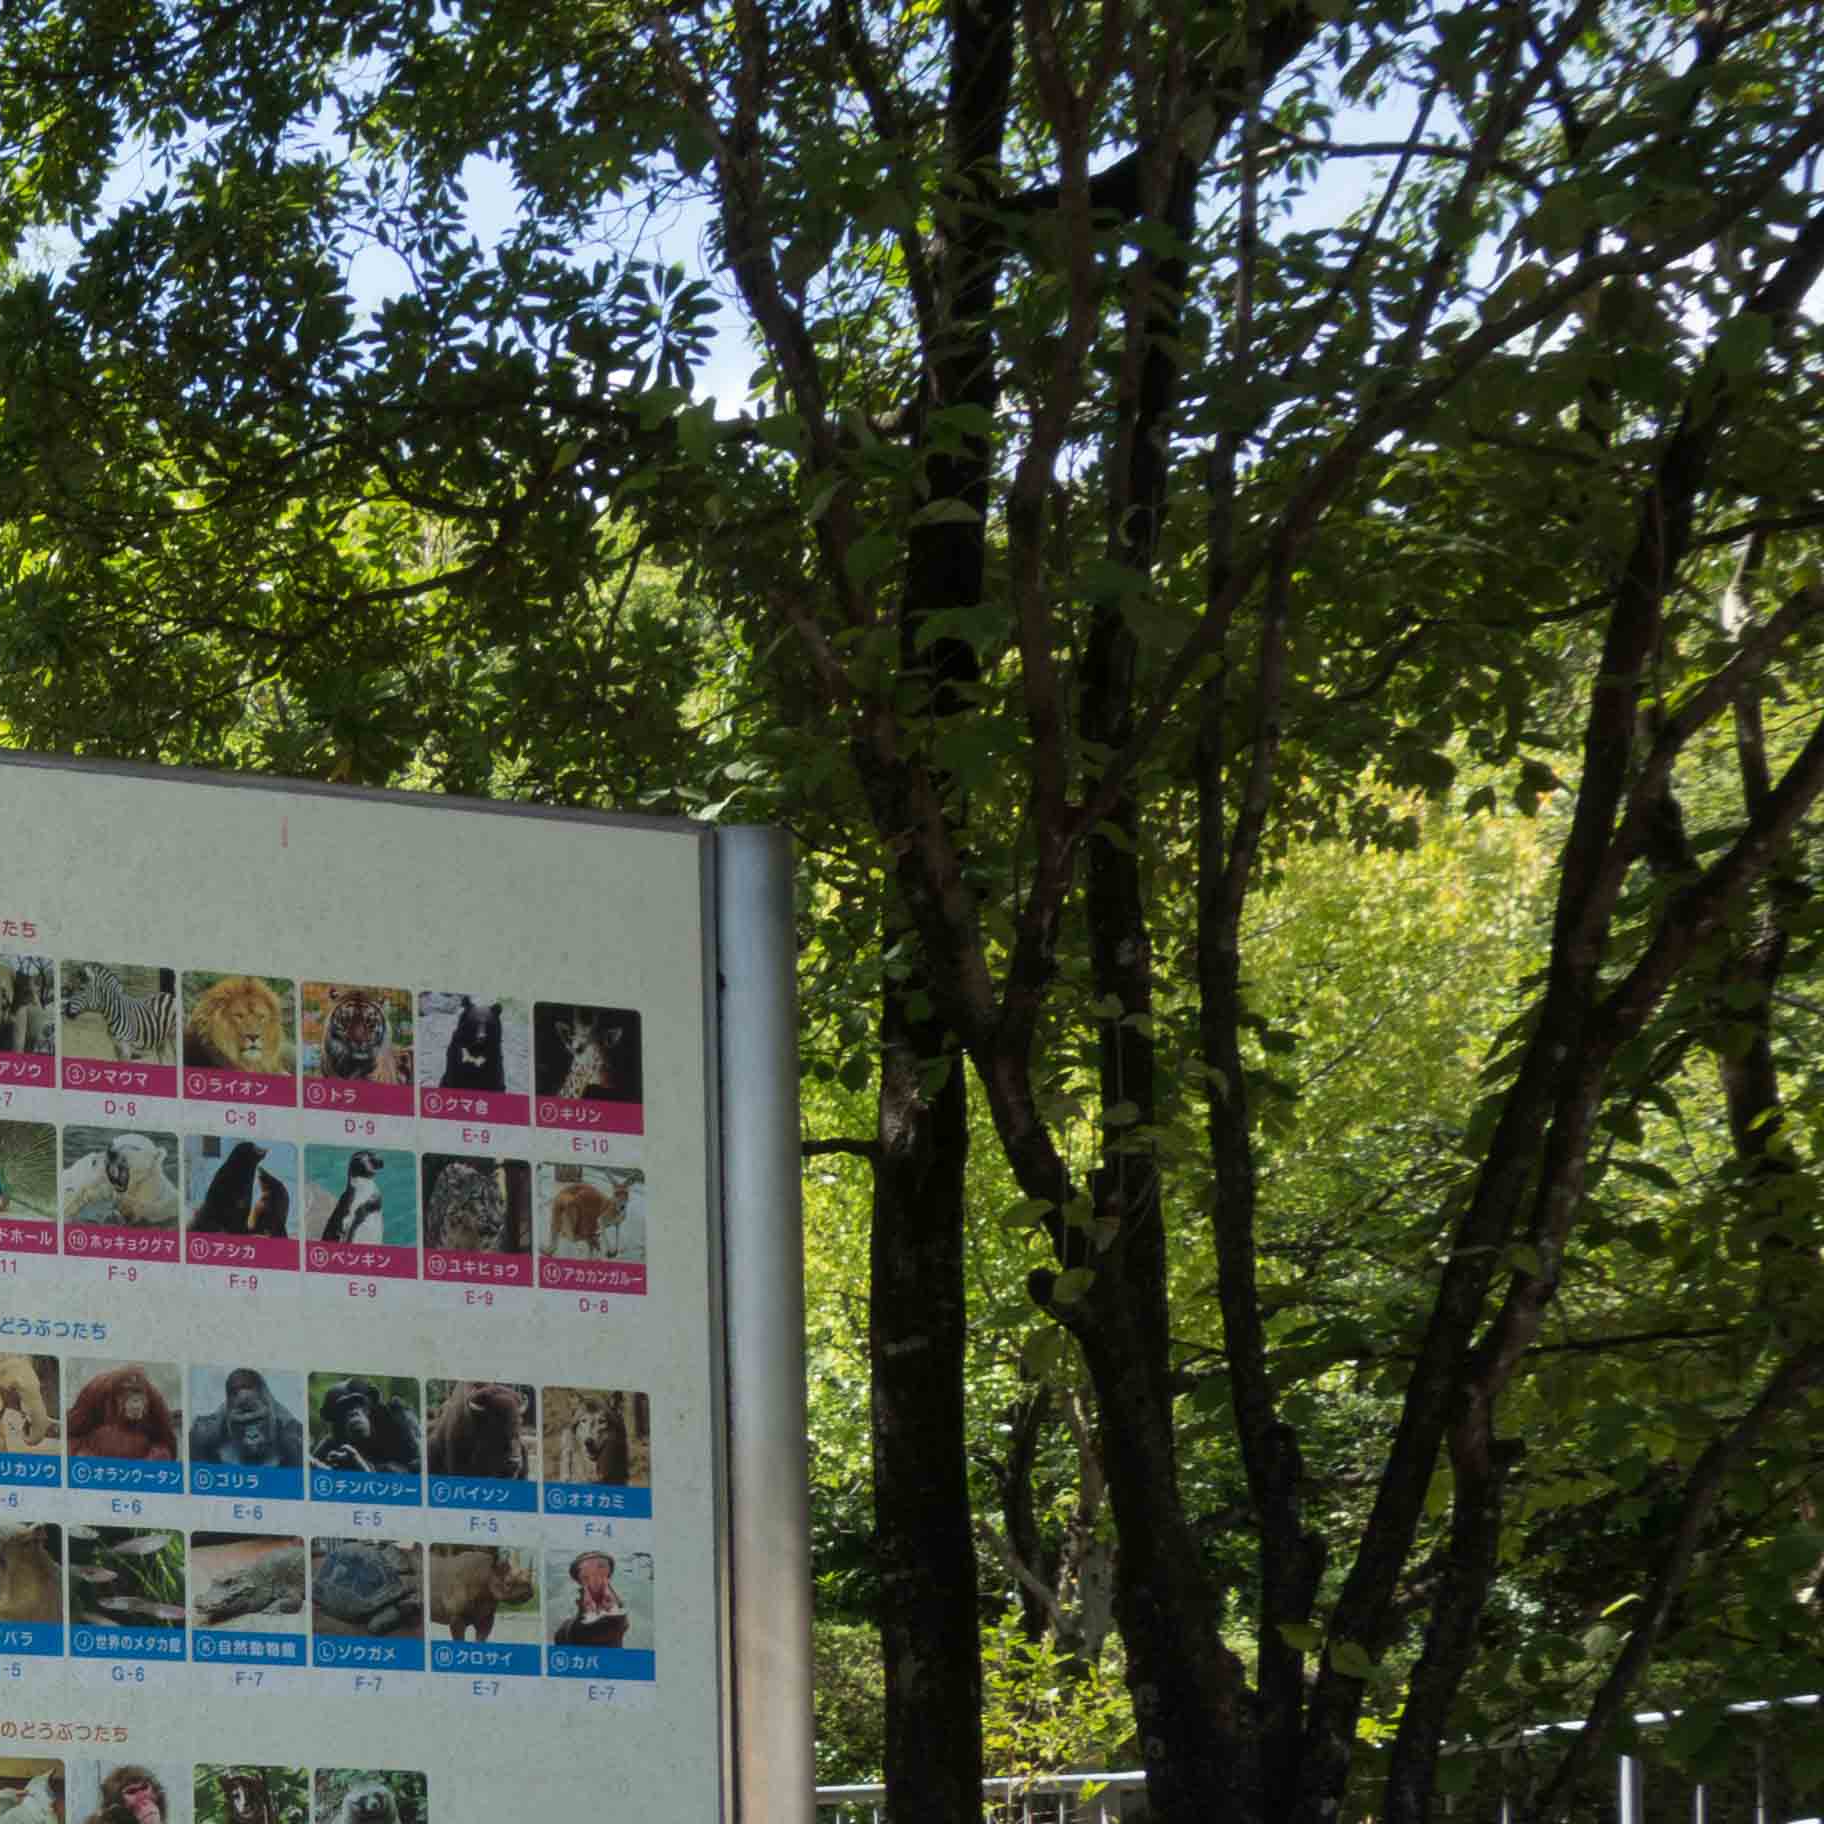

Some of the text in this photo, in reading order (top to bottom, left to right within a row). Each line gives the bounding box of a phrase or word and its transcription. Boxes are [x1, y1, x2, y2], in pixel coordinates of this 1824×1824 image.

[225, 1109, 257, 1127] C-8
[345, 1119, 376, 1137] D-9
[463, 1128, 491, 1146] E-9
[572, 1137, 609, 1155] E-10
[233, 1504, 263, 1521] E-6
[112, 1666, 145, 1683] G-6
[235, 1670, 265, 1687] F-7
[355, 1675, 383, 1692] F-7
